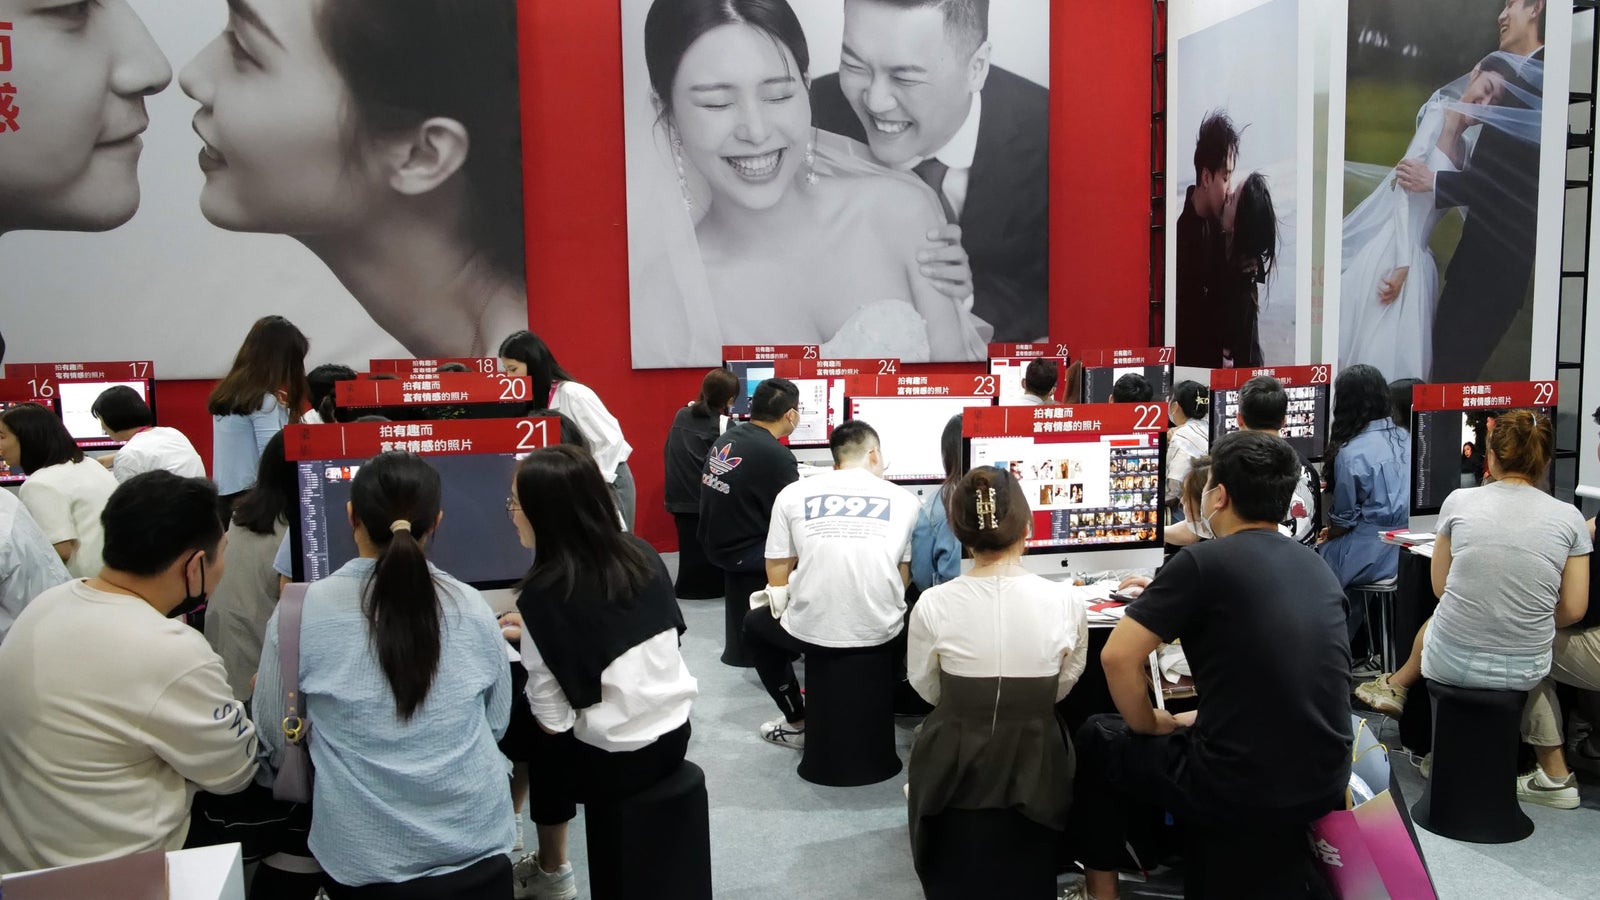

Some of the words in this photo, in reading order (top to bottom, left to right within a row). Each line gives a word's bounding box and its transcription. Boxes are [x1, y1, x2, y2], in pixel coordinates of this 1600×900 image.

[803, 346, 817, 359] 25
[1056, 344, 1068, 357] 26
[1158, 348, 1172, 363] 27
[129, 362, 149, 378] 17
[476, 358, 494, 373] 18
[878, 359, 897, 375] 24
[897, 377, 928, 385] 拍有趣而
[1310, 366, 1328, 384] 28
[27, 379, 54, 398] 16
[402, 381, 440, 391] 拍有趣而
[499, 378, 526, 400] 20
[973, 376, 995, 395] 23
[403, 392, 469, 402] 富有情感的照片
[1533, 383, 1554, 405] 29
[1033, 408, 1073, 419] 拍有趣而
[1133, 404, 1162, 430] 22
[380, 424, 433, 437] 拍有趣而
[515, 420, 548, 449] 21
[1033, 421, 1102, 433] 富有情感的照片
[380, 439, 472, 453] 富有情感的照片
[805, 495, 890, 519] 1997
